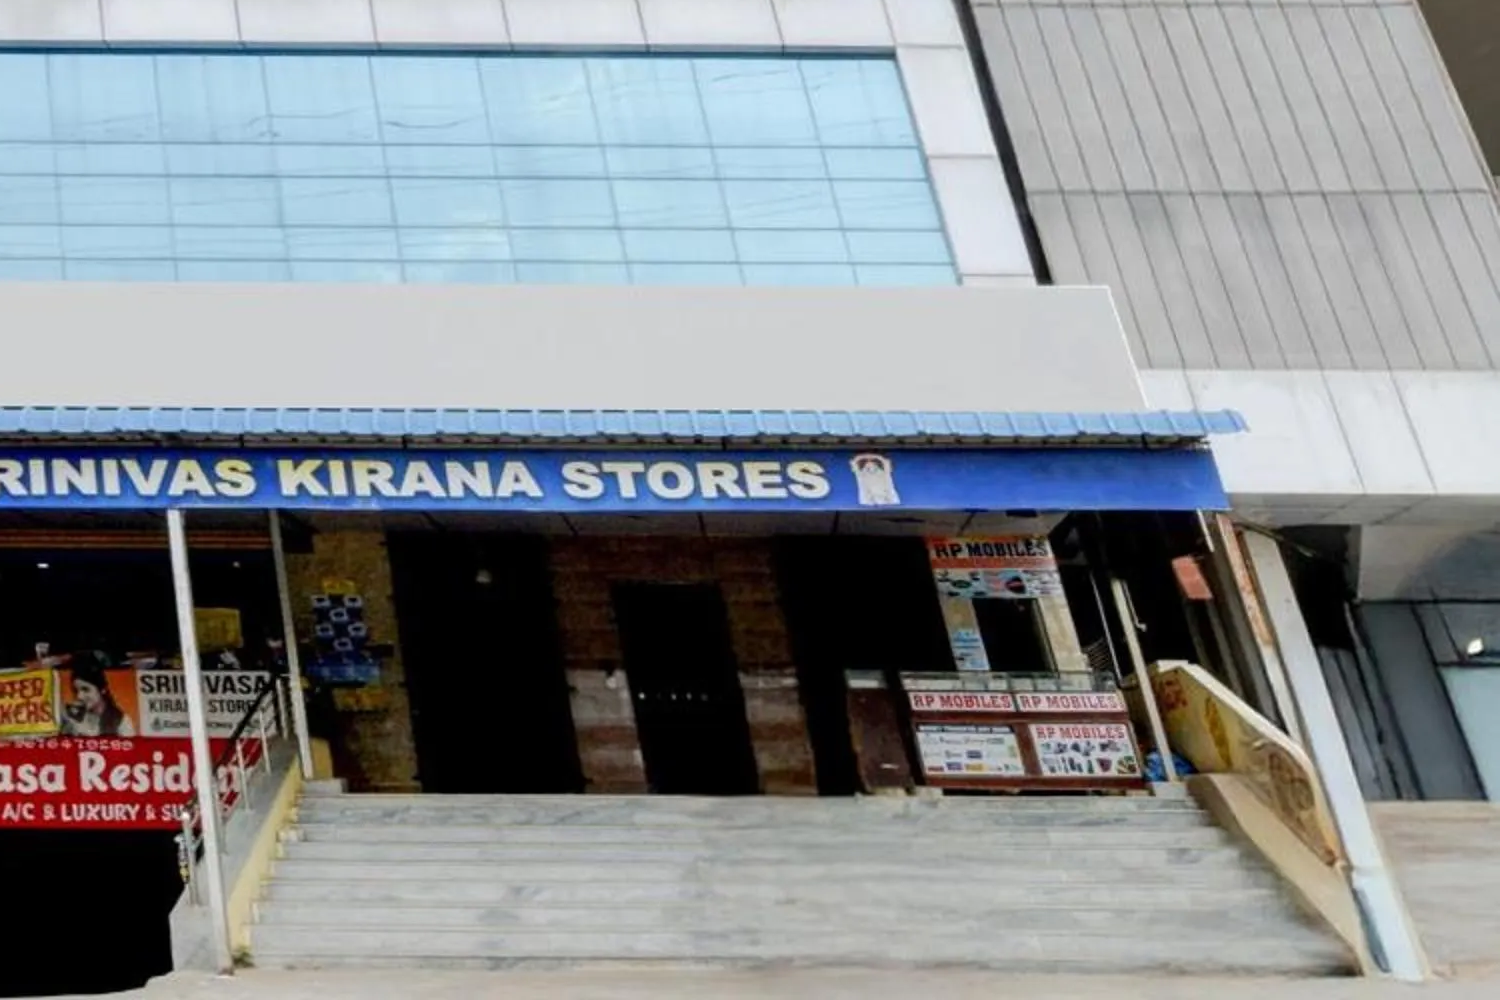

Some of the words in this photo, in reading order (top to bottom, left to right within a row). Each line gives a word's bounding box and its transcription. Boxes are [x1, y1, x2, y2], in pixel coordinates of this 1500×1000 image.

[277, 459, 543, 499] KIRANA
[562, 461, 831, 500] STORES
[965, 537, 1049, 558] MOBILES
[140, 675, 268, 694] SRIVASA
[913, 695, 936, 708] RP
[940, 695, 1013, 709] MOBILES
[1020, 695, 1043, 709] RP
[1036, 726, 1058, 739] RP
[1060, 727, 1126, 740] MOBILES
[3, 803, 35, 822] A/C
[61, 803, 140, 821] LUXURY
